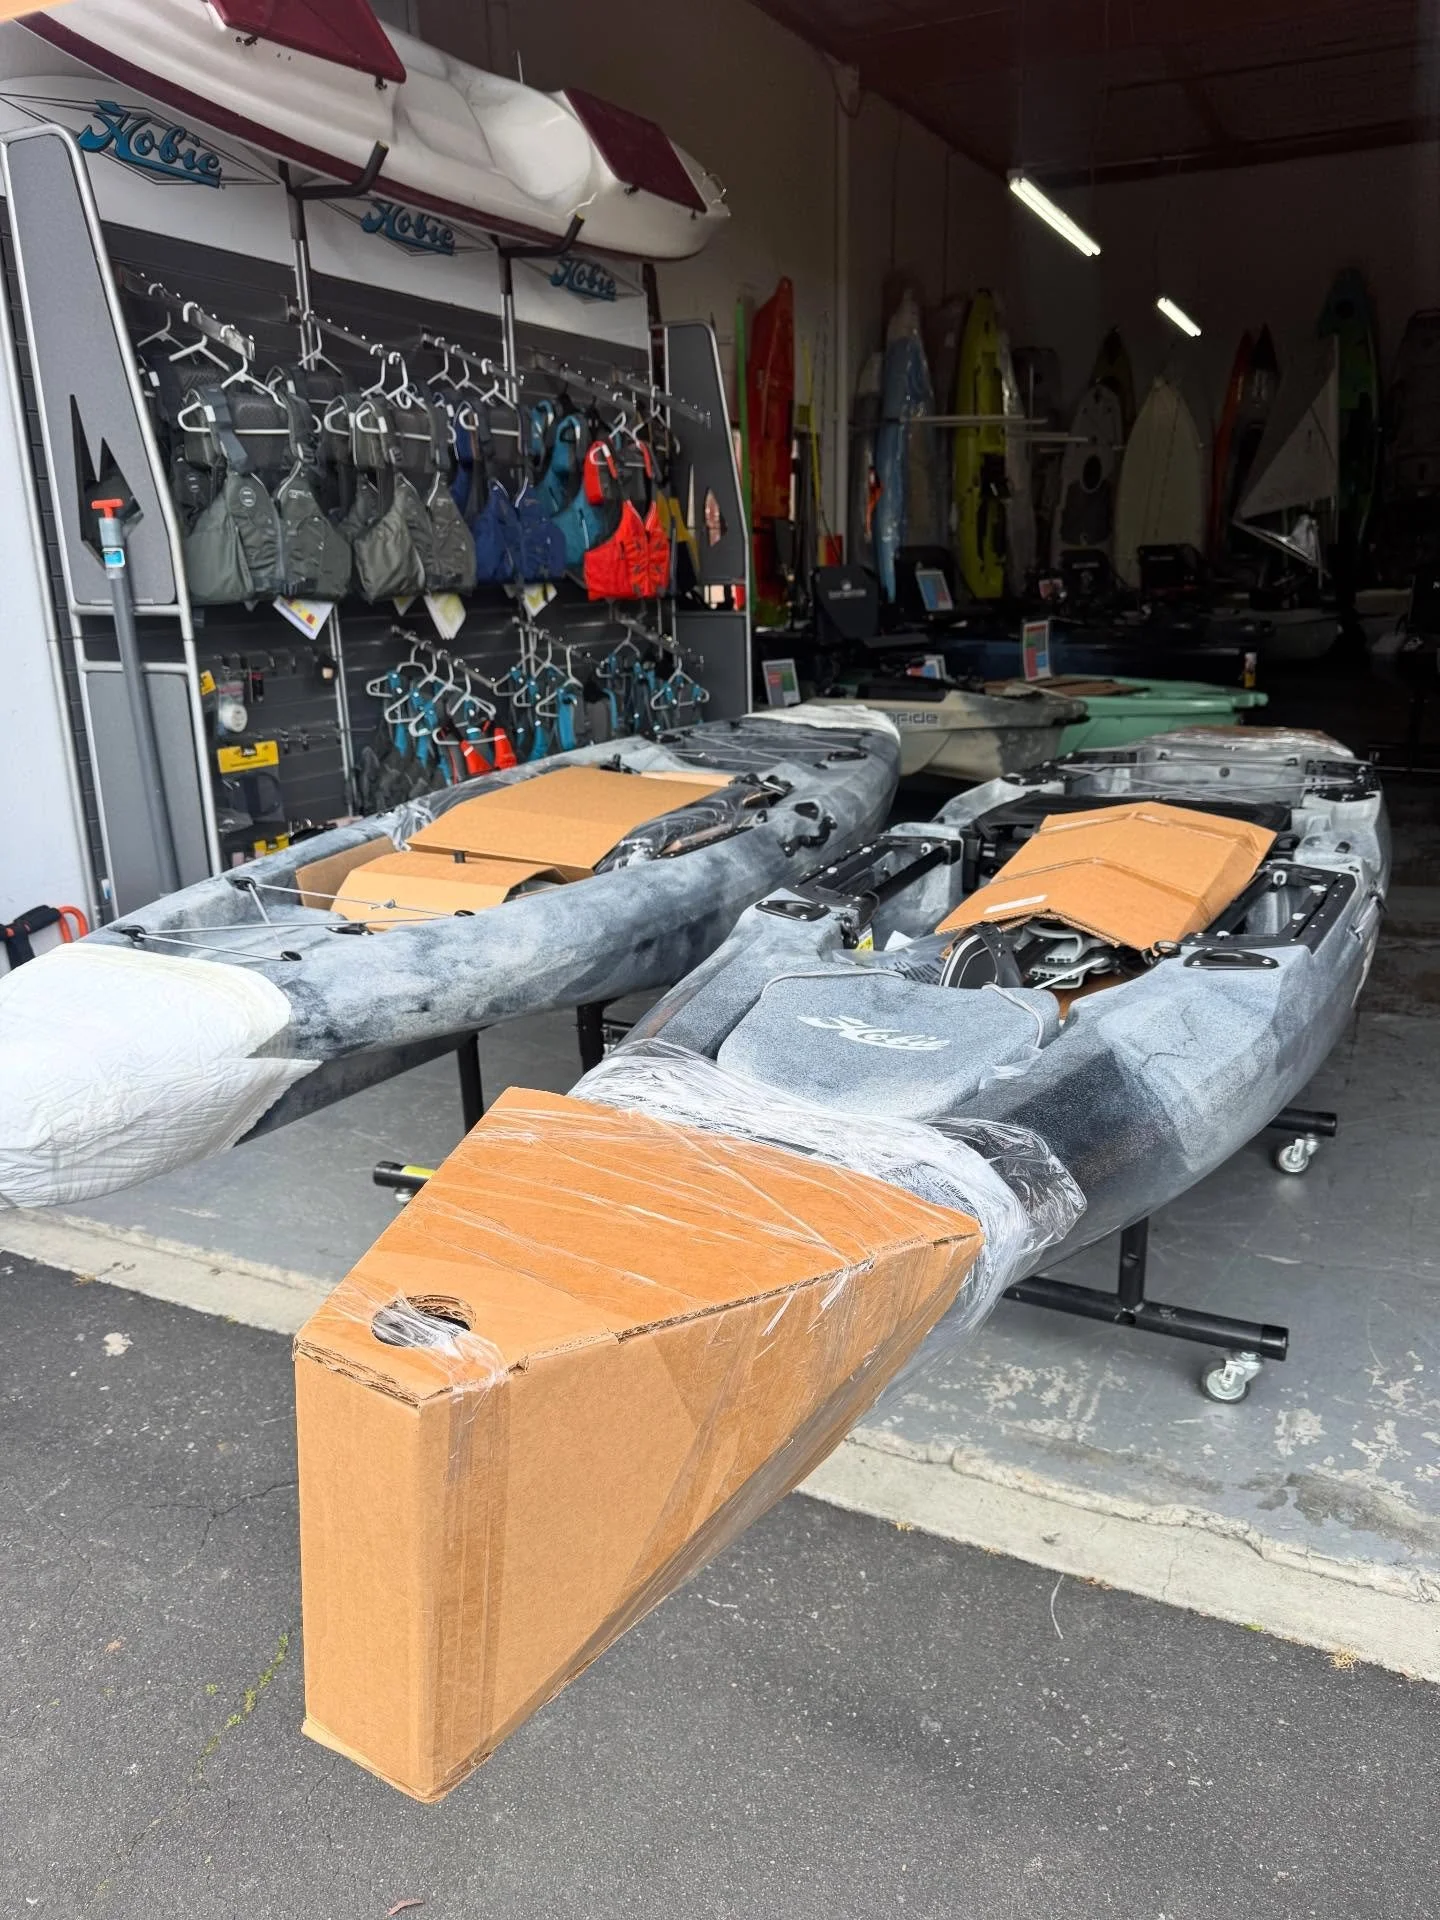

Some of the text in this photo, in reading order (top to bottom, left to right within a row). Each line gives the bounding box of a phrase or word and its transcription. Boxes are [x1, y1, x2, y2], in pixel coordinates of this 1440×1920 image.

[77, 100, 222, 188] Hobie
[361, 201, 455, 256] Hobie
[549, 257, 617, 302] Hobie
[797, 1015, 951, 1050] Hobie
